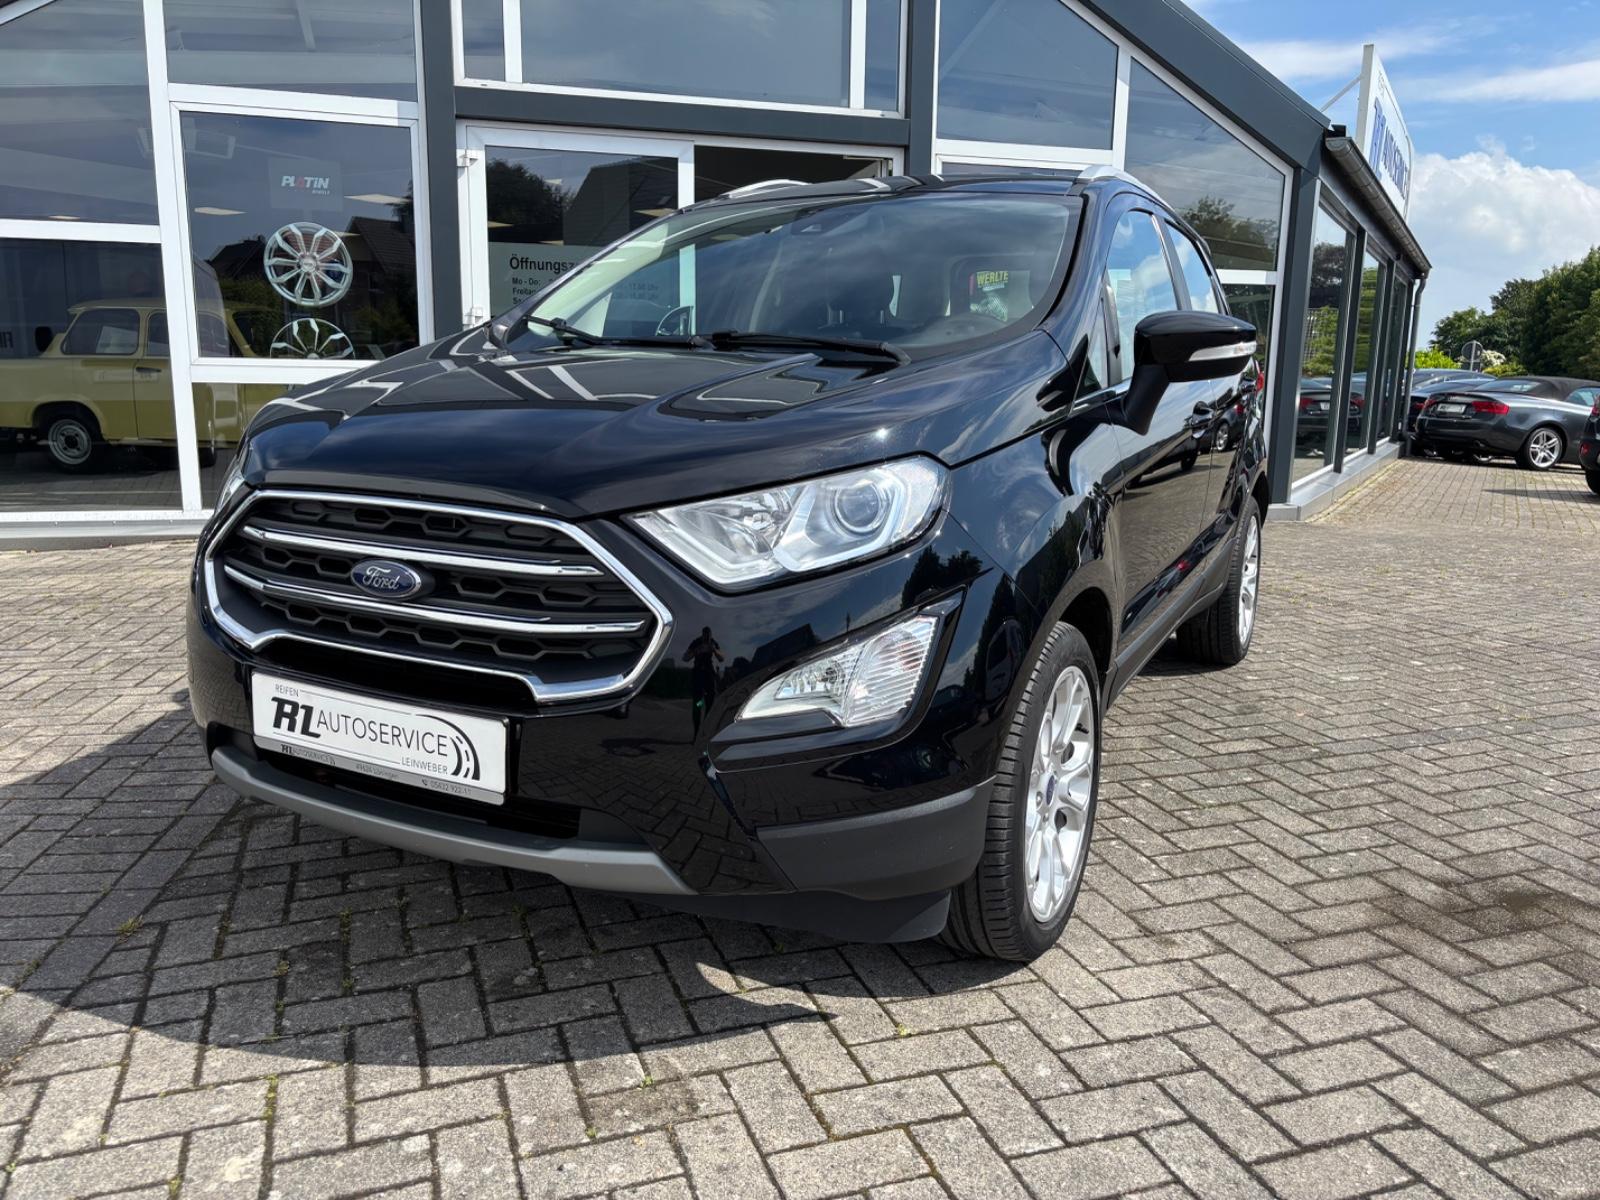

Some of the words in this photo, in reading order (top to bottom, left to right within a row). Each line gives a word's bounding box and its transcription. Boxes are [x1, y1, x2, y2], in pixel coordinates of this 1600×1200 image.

[509, 253, 576, 273] Öffnungsz
[512, 277, 523, 285] Mo
[362, 566, 401, 590] Ford
[275, 683, 300, 698] REIFEN
[271, 696, 321, 739] RL
[317, 709, 448, 757] AUTOSERVICE
[401, 757, 448, 775] LEINWEBER
